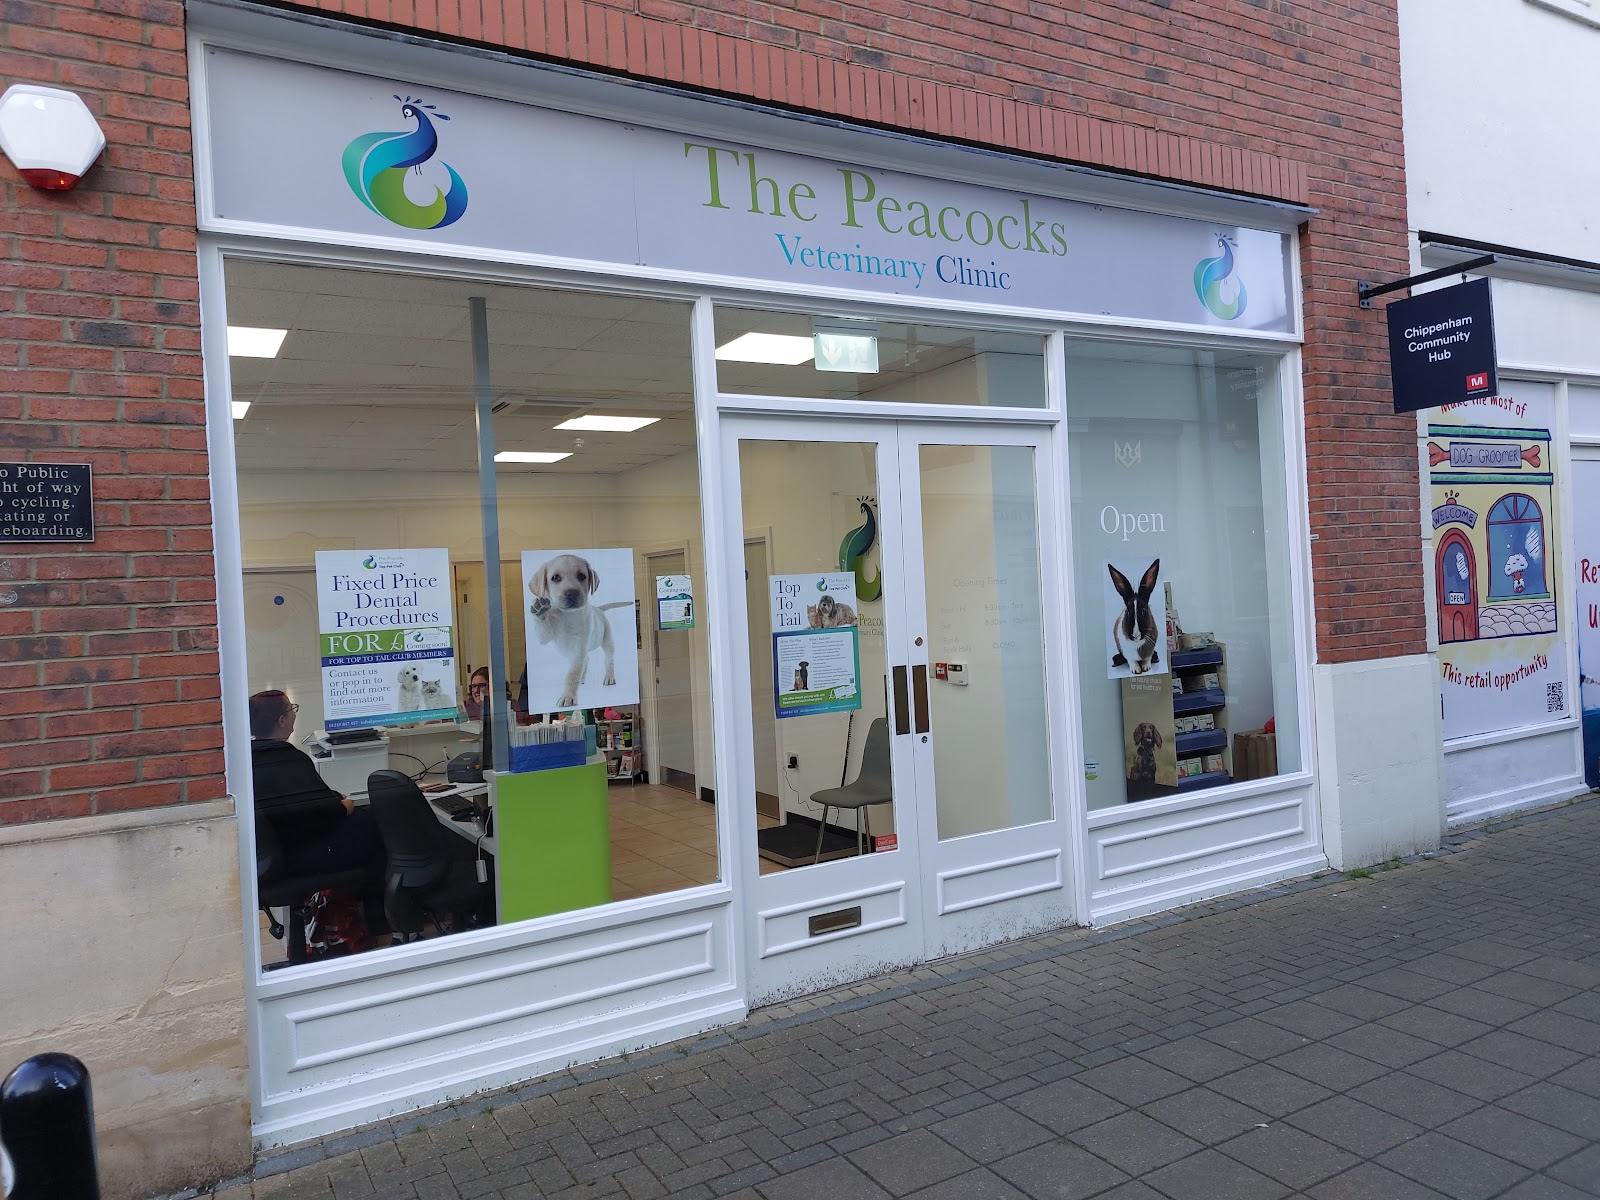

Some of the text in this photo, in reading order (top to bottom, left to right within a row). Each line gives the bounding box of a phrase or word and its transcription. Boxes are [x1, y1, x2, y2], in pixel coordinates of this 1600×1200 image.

[684, 142, 1068, 257] The Peacocks
[774, 232, 1012, 290] Veterinary Clinic
[1404, 316, 1472, 338] Chippenham
[1408, 330, 1470, 352] Community
[1429, 349, 1451, 362] Hub
[1472, 378, 1483, 386] M
[1490, 396, 1513, 411] most
[1516, 403, 1527, 418] of
[1454, 448, 1519, 464] DOG GROOMER
[0, 466, 69, 478] o Public
[27, 482, 44, 492] of
[51, 484, 81, 495] way
[12, 497, 74, 509] cycling,
[0, 510, 46, 523] ating
[1432, 508, 1474, 525] WELCOME
[1100, 506, 1165, 541] Open
[0, 525, 88, 537] eboarding.
[332, 573, 438, 592] Fixed Price
[953, 577, 1007, 587] Opening Times
[775, 581, 800, 597] Top
[355, 591, 418, 609] Dental
[776, 597, 793, 610] To
[1450, 595, 1464, 603] OPEN
[336, 609, 438, 627] Procedures
[777, 613, 801, 626] Tail
[859, 614, 884, 626] Peaco
[328, 634, 383, 654] FOR
[390, 632, 404, 651] £
[412, 650, 447, 658] MEMBERS
[329, 670, 365, 678] Contact
[1443, 654, 1548, 691] This retail opportunity
[342, 680, 360, 689] pop
[330, 696, 384, 706] information
